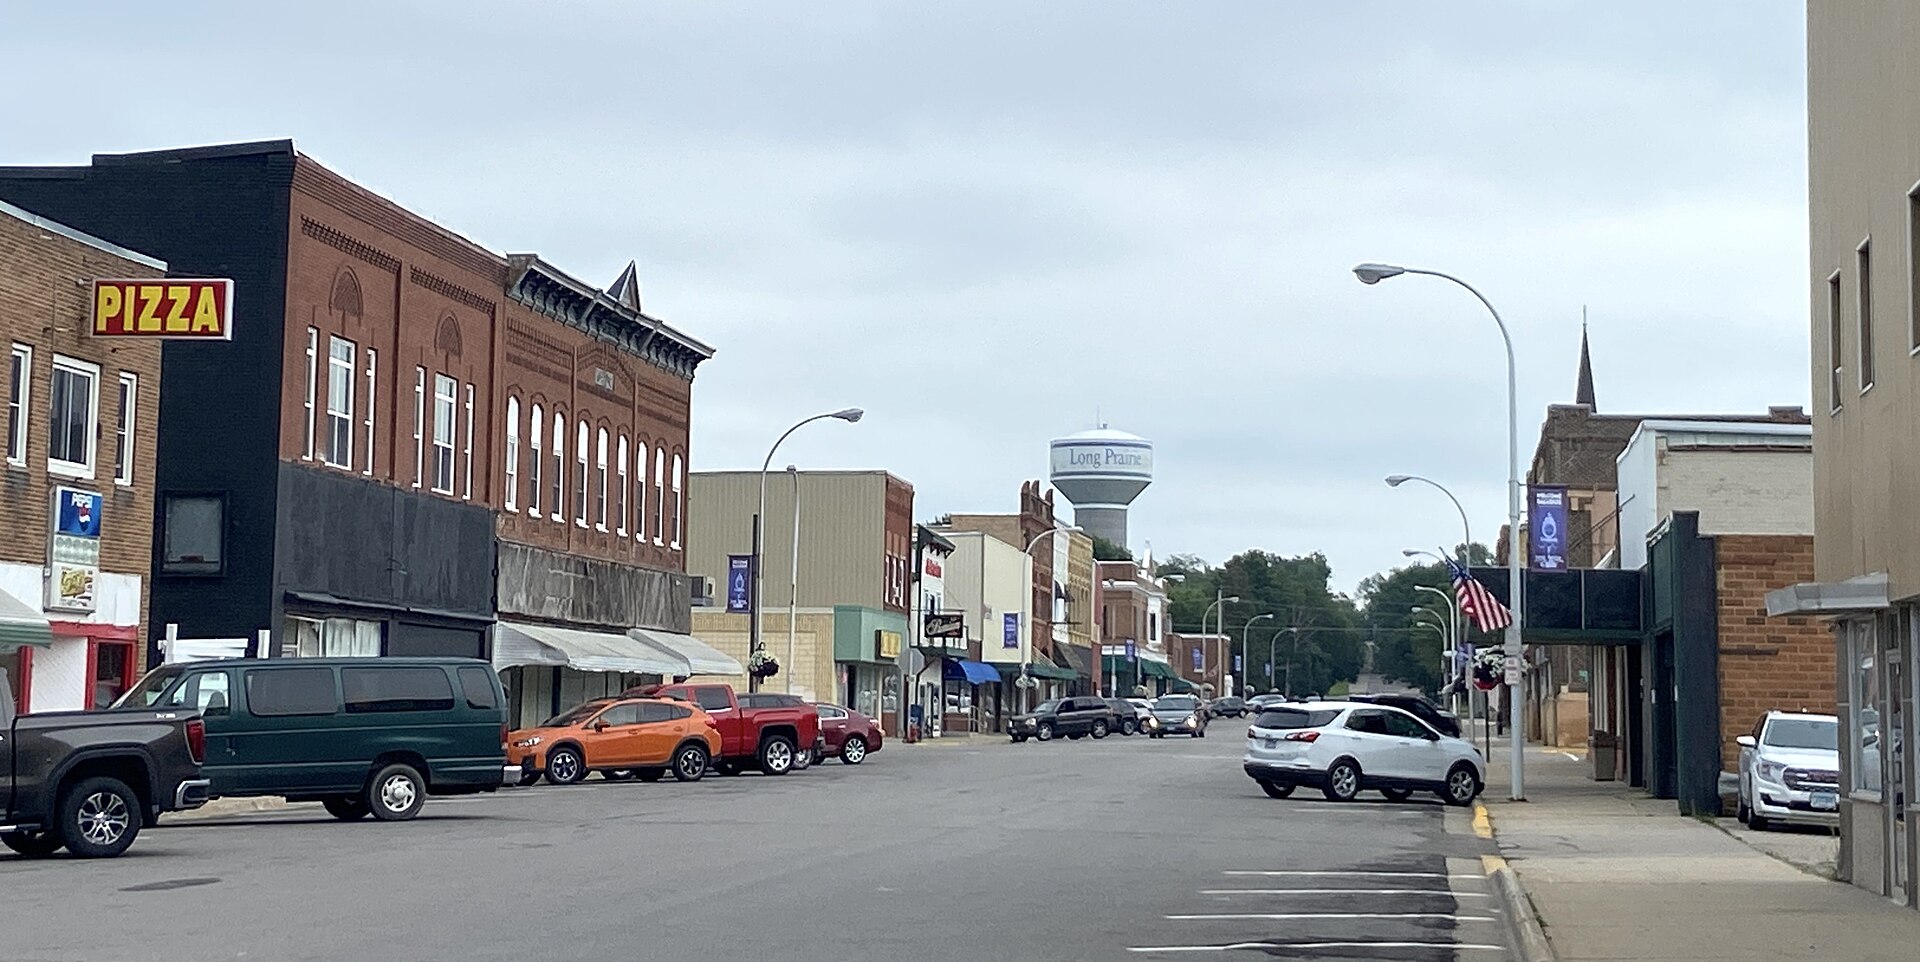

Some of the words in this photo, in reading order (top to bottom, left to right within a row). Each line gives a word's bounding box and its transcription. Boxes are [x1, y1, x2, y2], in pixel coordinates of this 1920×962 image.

[97, 285, 220, 333] PIZZA
[1070, 448, 1101, 469] Long
[1105, 448, 1142, 465] Prairie
